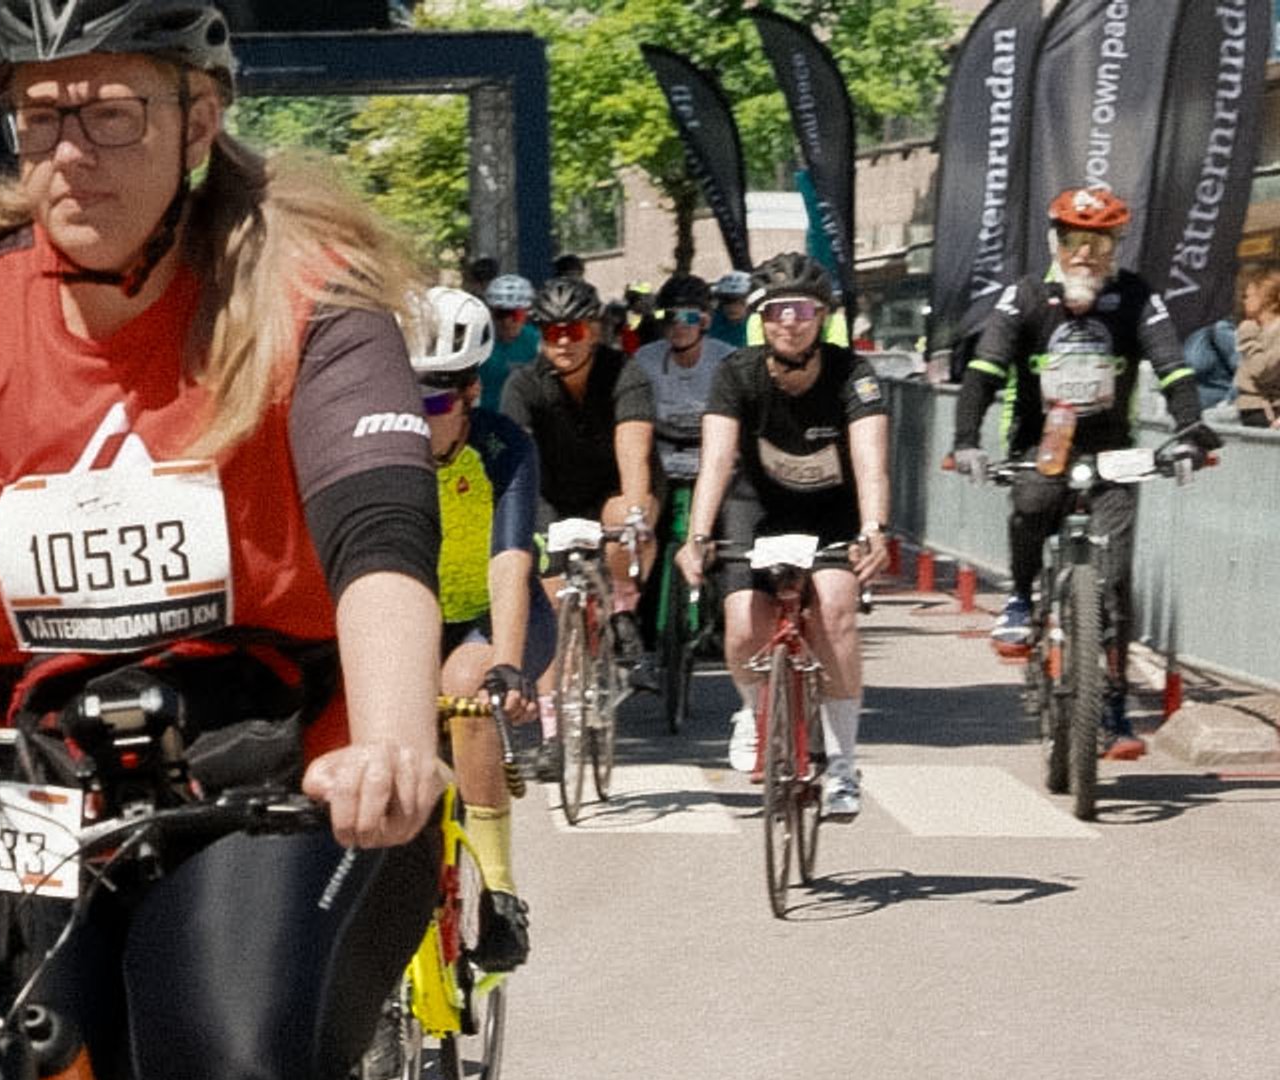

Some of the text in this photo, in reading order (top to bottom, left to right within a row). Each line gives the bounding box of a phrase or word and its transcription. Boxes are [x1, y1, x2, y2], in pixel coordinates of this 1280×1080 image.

[1101, 0, 1130, 58] pac
[1092, 63, 1122, 126] own
[1164, 0, 1247, 300] Vätternrund
[30, 520, 190, 595] 10533
